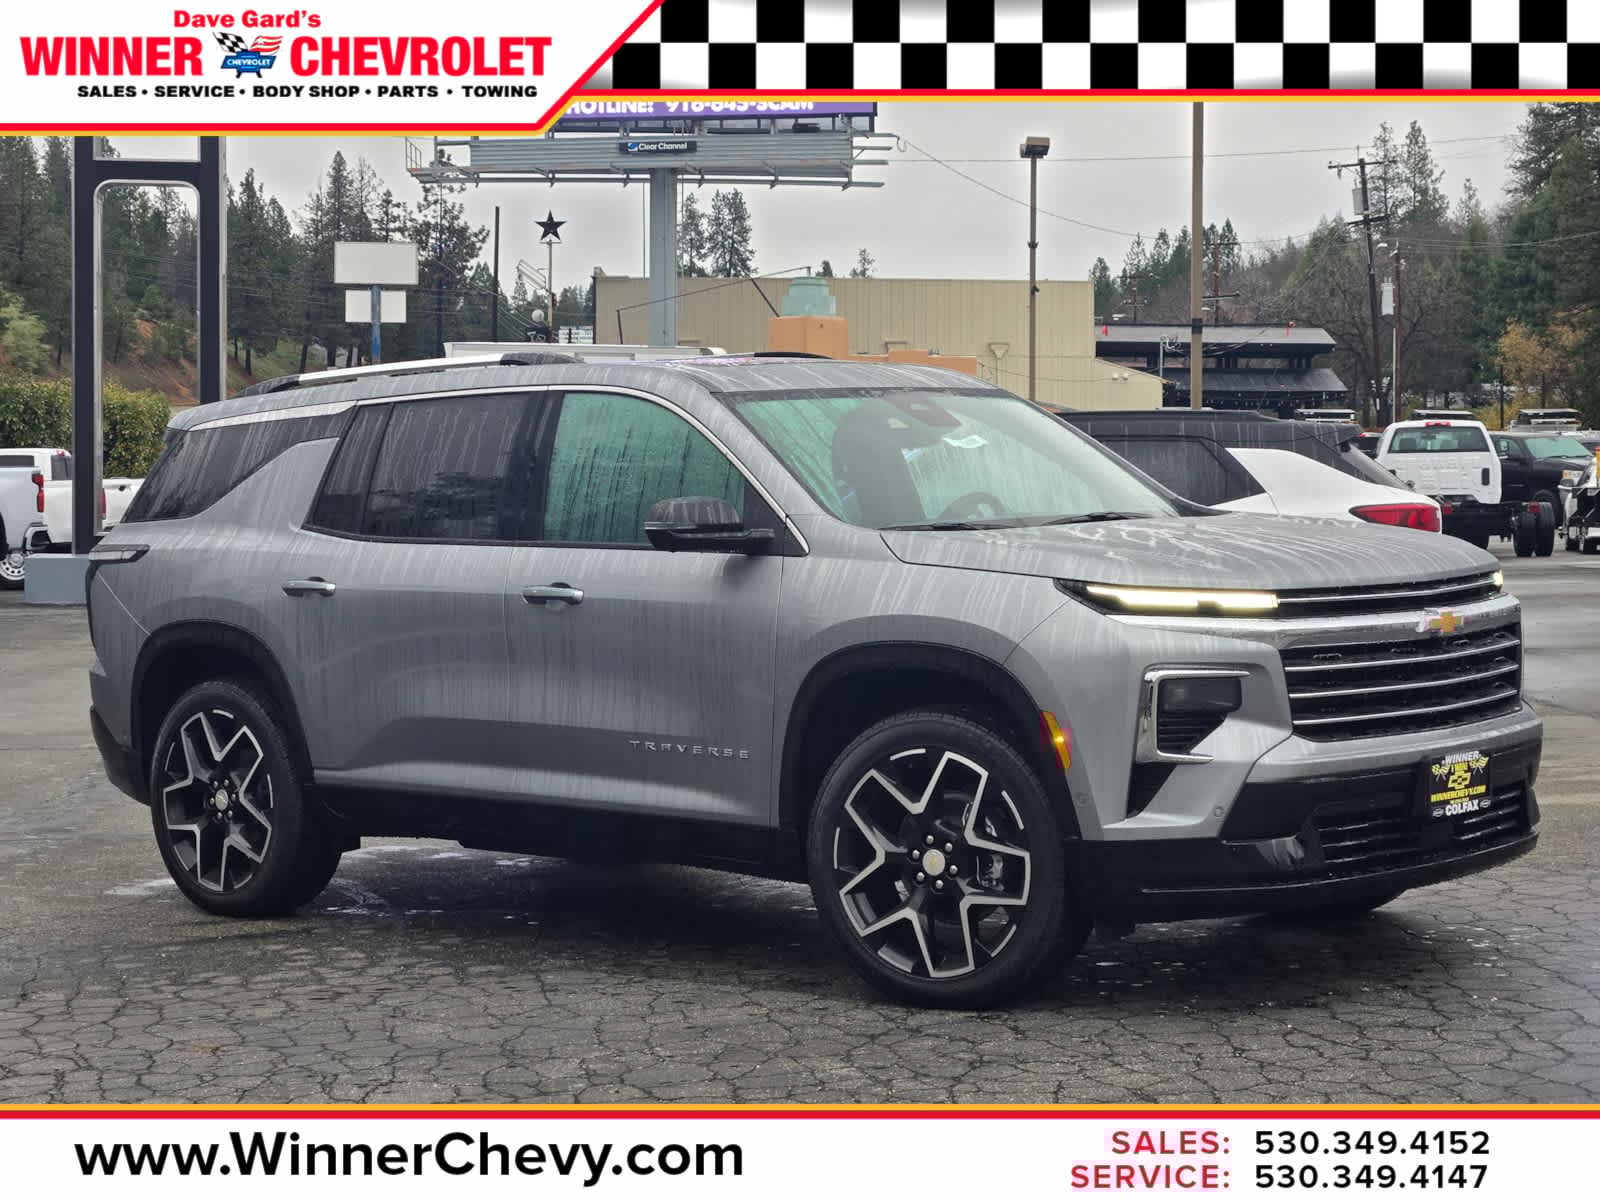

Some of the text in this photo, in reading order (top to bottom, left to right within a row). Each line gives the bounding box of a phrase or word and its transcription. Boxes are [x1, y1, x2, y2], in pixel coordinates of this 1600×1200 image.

[638, 142, 688, 151] Clear Channel
[629, 740, 749, 759] TRAVERSE
[1445, 750, 1480, 764] WINNER
[1445, 799, 1479, 816] COLFAX
